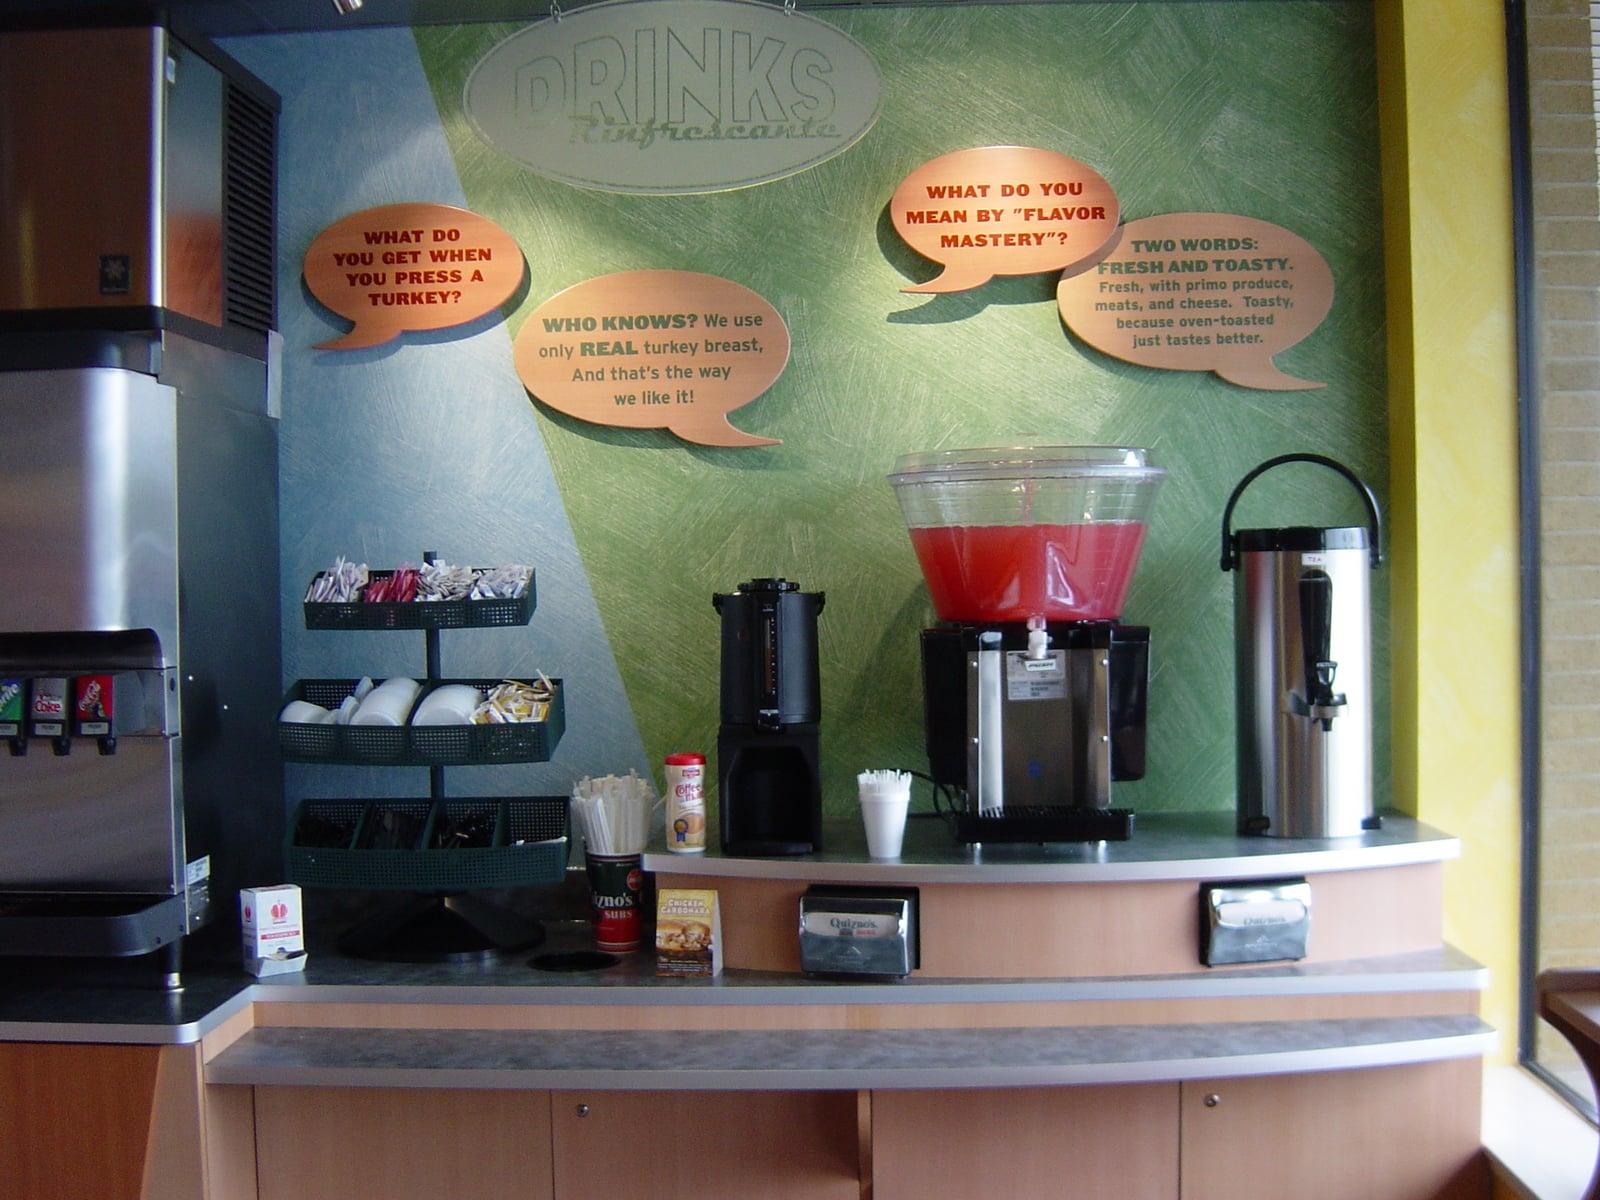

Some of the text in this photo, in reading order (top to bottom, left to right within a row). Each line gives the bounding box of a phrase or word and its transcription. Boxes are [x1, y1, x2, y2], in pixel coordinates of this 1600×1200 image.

[514, 27, 837, 129] DRINKS
[567, 114, 842, 150] Rinfrescante
[926, 182, 1083, 199] WHAT DO YOU
[906, 206, 1105, 224] MEAN BY "FLAVOR
[364, 229, 460, 244] WHAT DO
[940, 232, 1068, 248] MASTERY"?
[1131, 238, 1259, 253] TWO WORDS:
[334, 248, 492, 267] YOU GET WHEN
[1098, 257, 1294, 275] FRESH AND TOASTY.
[346, 269, 484, 287] YOU PRESS A
[1099, 278, 1294, 294] Fresh, with primo produce,
[368, 291, 462, 306] TURKEY?
[1095, 295, 1294, 313] meats, and cheese. Toasty,
[542, 314, 763, 333] WHO KNOWS? We use
[1116, 314, 1275, 329] because oven-toasted
[539, 337, 764, 360] only REAL turkey breast,
[1132, 332, 1264, 348] just tastes better.
[572, 365, 732, 382] And that's the way
[614, 389, 694, 406] we like it!
